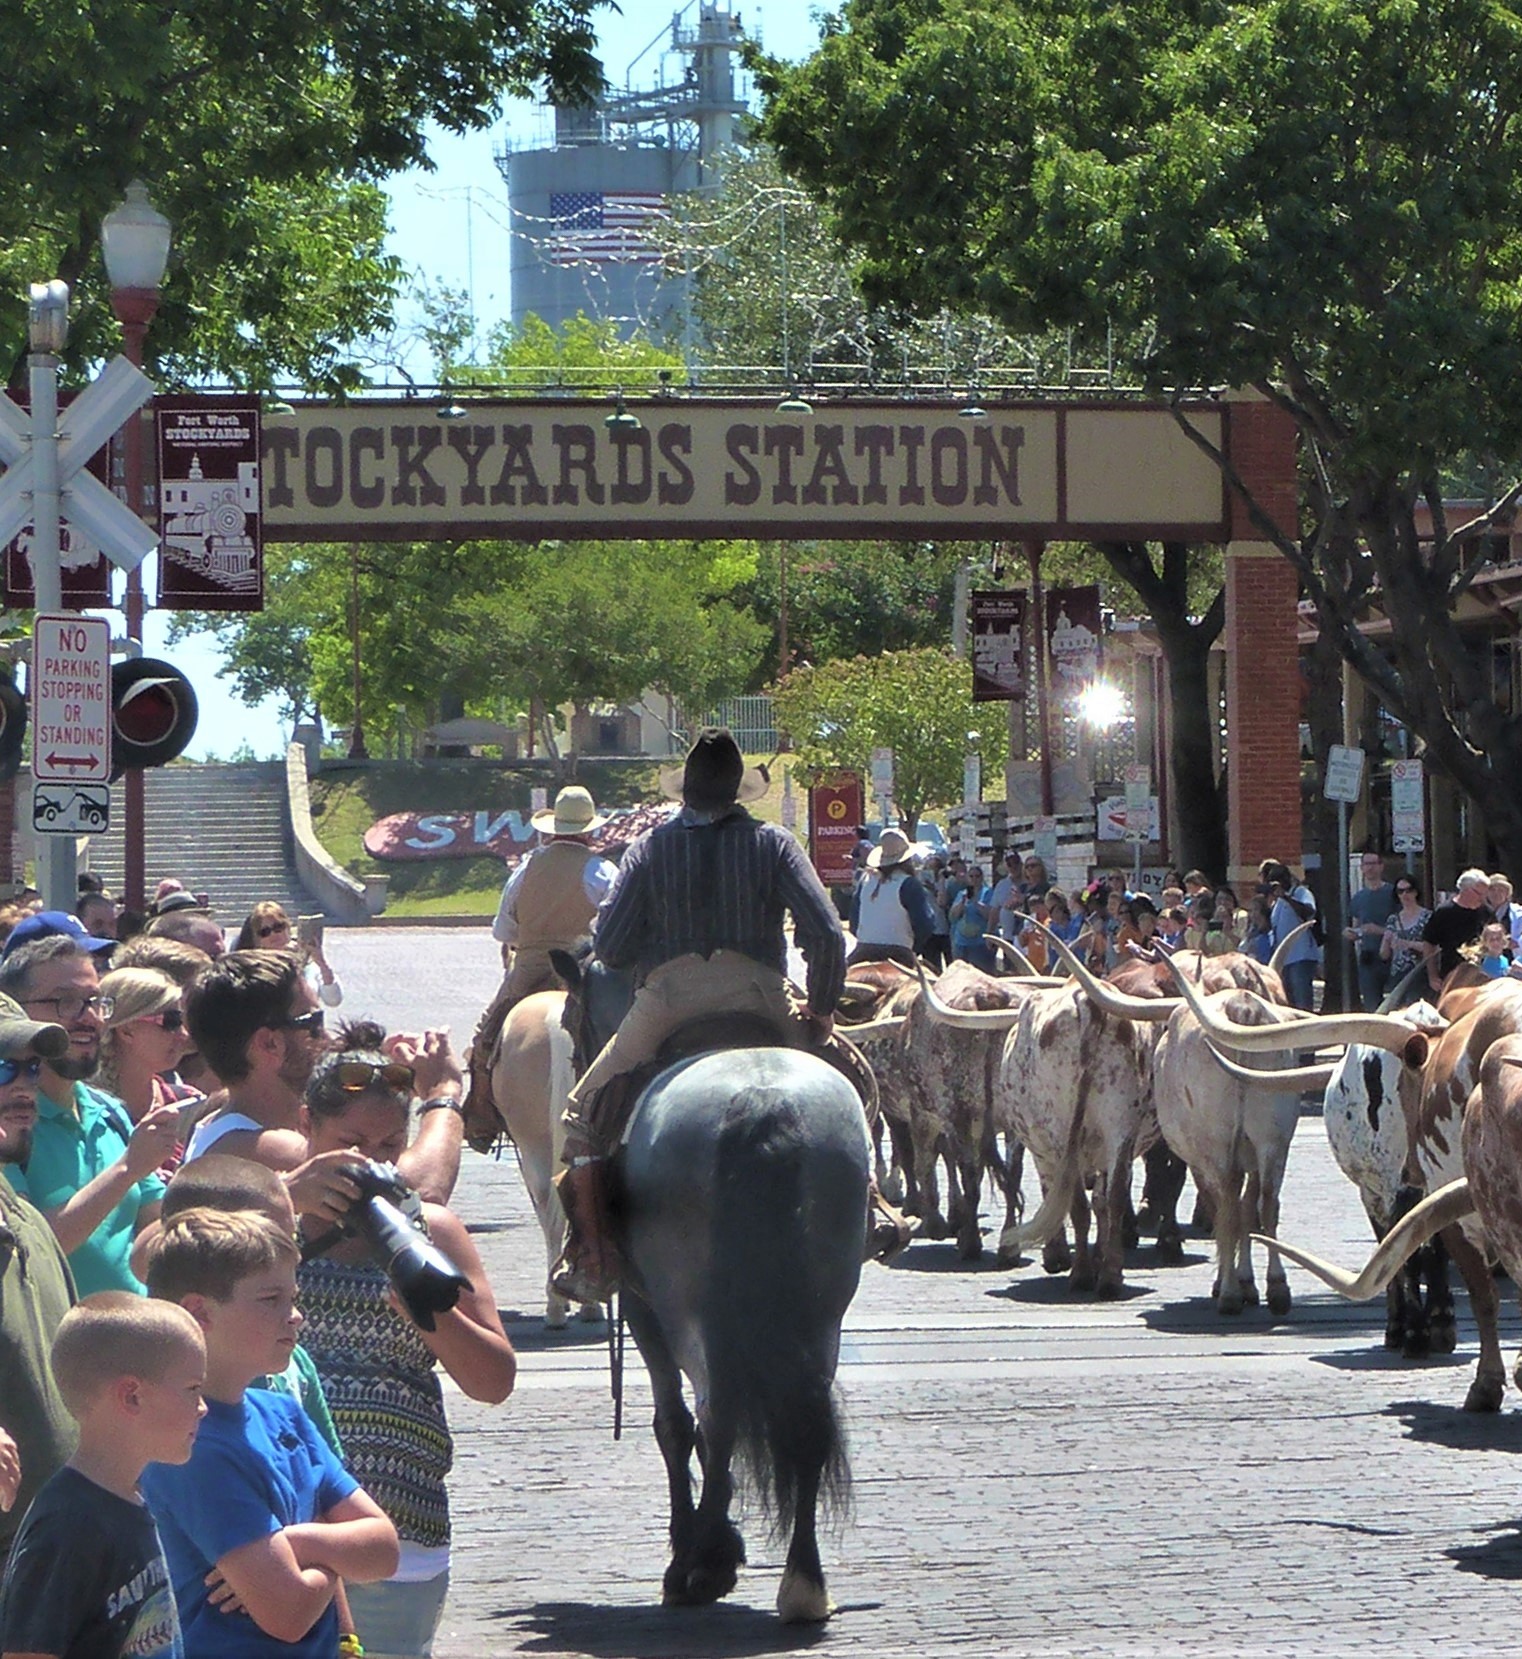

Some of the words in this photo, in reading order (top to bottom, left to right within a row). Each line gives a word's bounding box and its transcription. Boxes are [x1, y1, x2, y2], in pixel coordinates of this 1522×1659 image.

[178, 415, 201, 426] Fort
[207, 414, 239, 426] Worth
[165, 428, 250, 440] STOCKYARDS
[262, 423, 695, 508] TOCKYARDS
[725, 423, 1025, 507] STATION
[59, 628, 87, 652] NO
[45, 658, 100, 678] PARKING
[42, 680, 103, 701] STOPPING
[64, 704, 81, 722] OR
[40, 725, 104, 746] STANDING
[818, 826, 857, 836] PARKING
